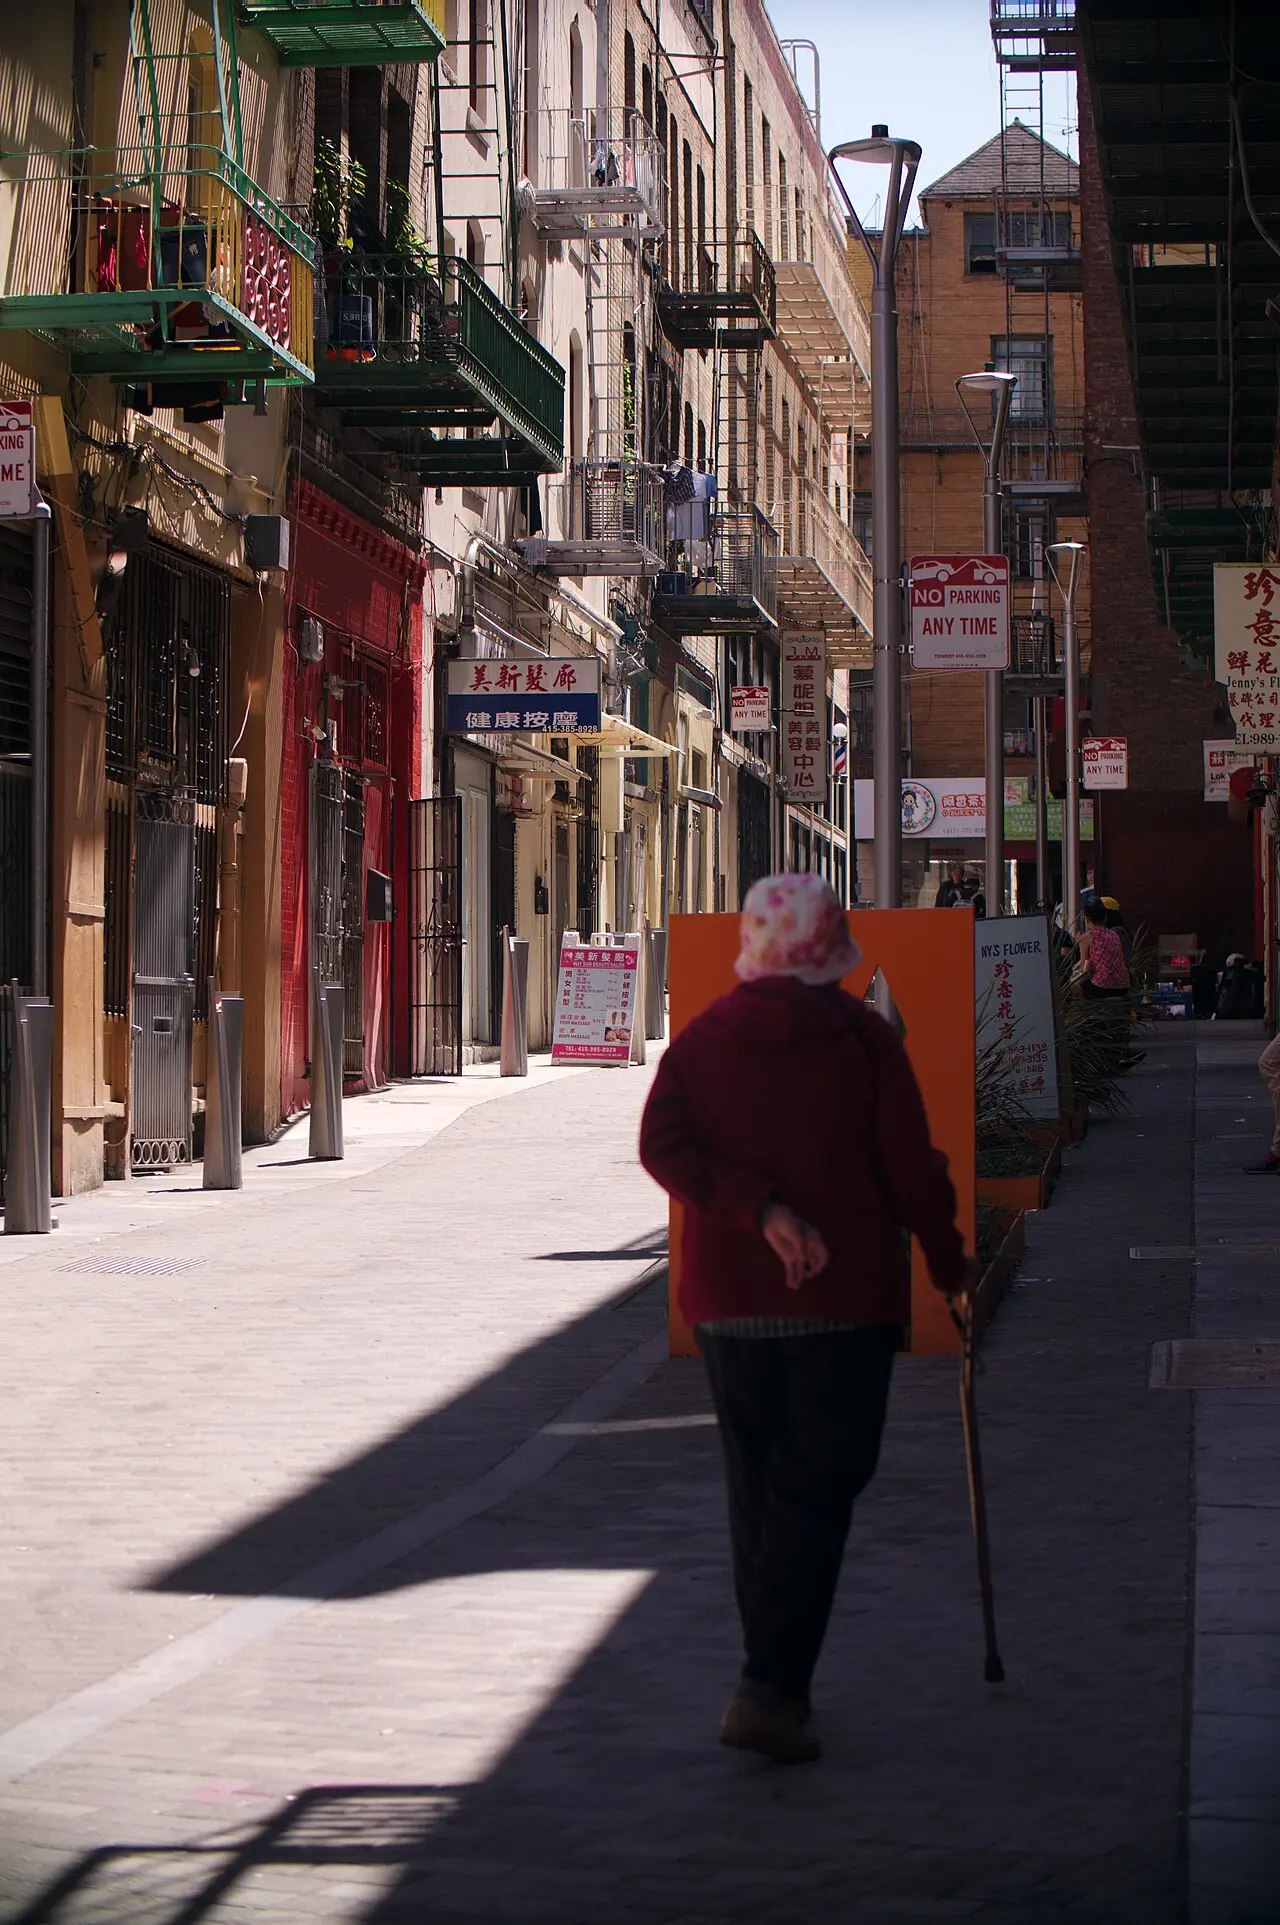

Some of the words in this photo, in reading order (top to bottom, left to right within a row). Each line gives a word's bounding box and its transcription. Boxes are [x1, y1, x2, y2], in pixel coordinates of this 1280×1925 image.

[914, 589, 942, 604] NO
[949, 589, 1001, 604] PARKING
[922, 617, 955, 635] ANY
[959, 617, 998, 635] TIME
[469, 663, 577, 693] 美新髮廊
[1226, 676, 1265, 690] Jenny's
[732, 699, 744, 707] NO
[734, 710, 749, 718] ANY
[750, 710, 767, 718] TIME
[1239, 711, 1280, 729] 代理
[541, 724, 599, 733] 415-385-8928
[1084, 752, 1098, 761] NO
[1100, 752, 1124, 760] PARKING
[1086, 765, 1102, 774] ANY
[1105, 765, 1124, 774] TIME
[1003, 940, 1042, 956] FLOWER
